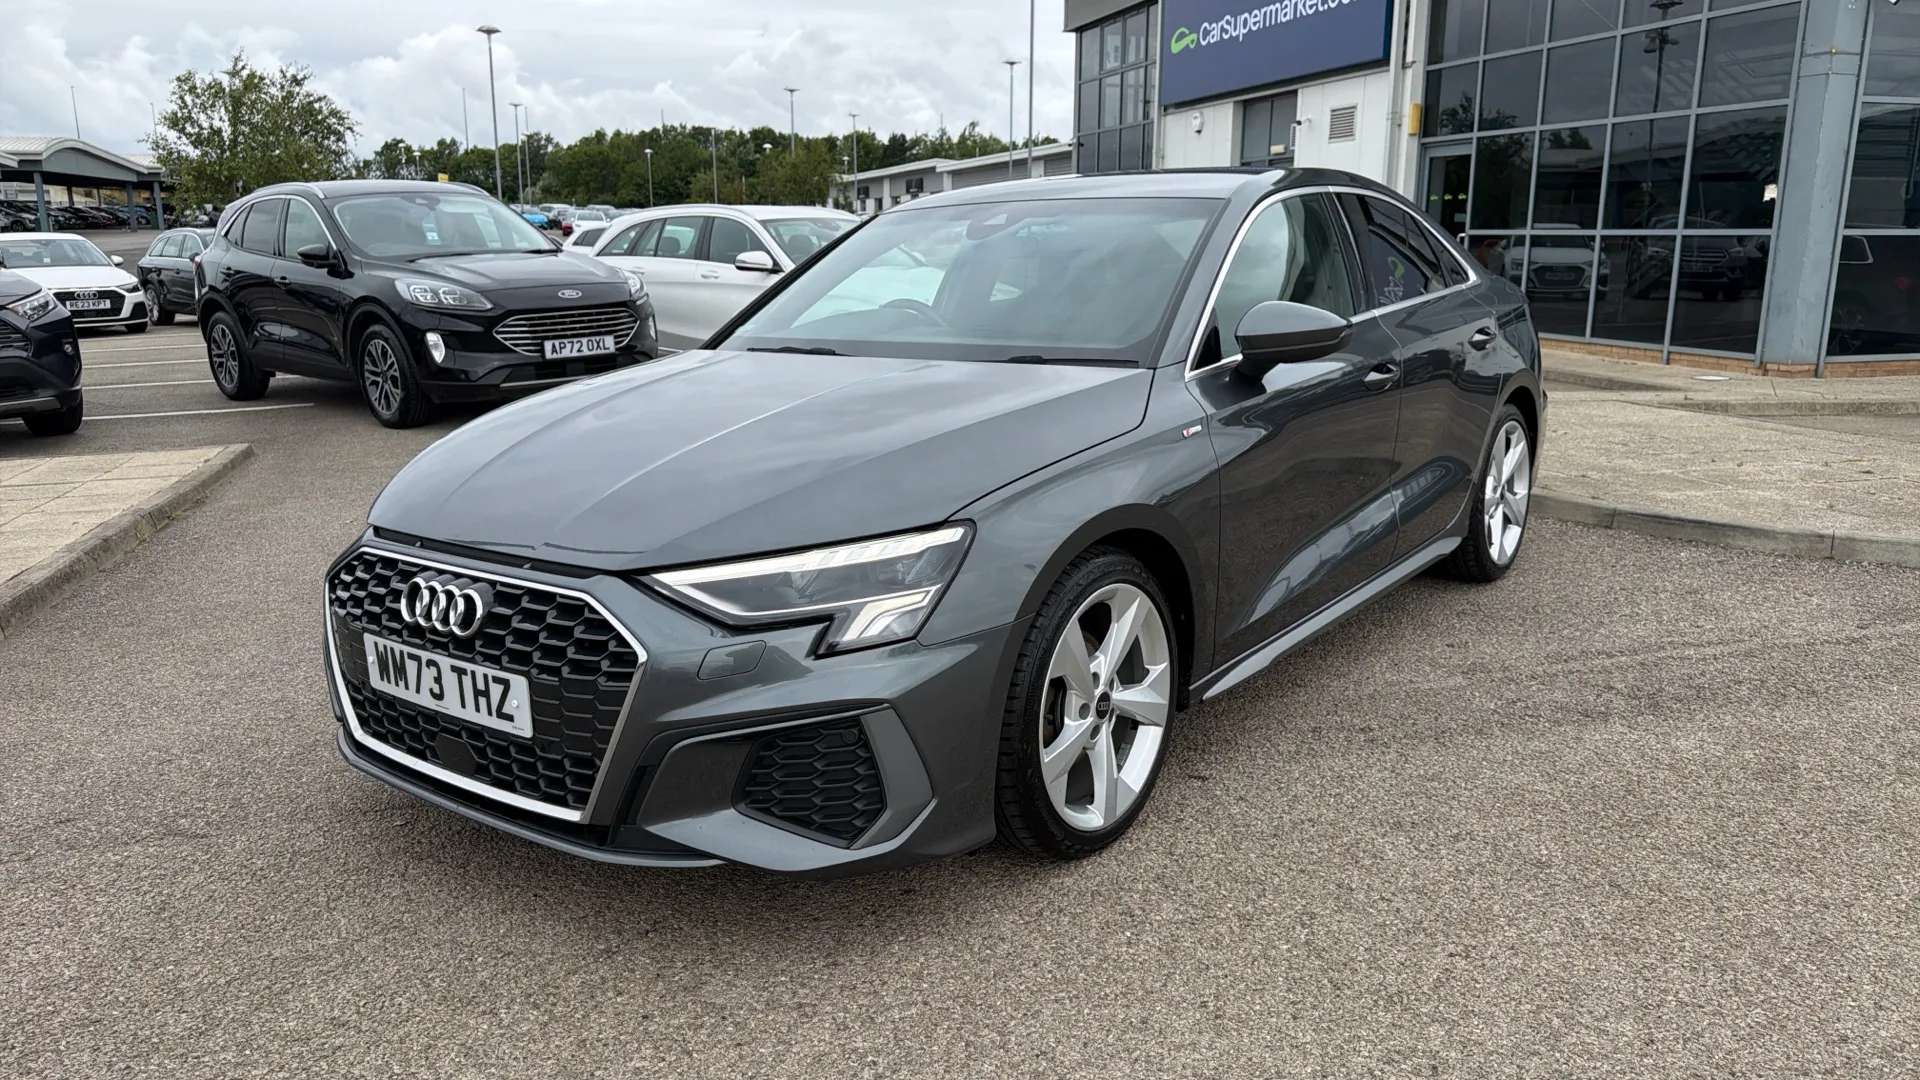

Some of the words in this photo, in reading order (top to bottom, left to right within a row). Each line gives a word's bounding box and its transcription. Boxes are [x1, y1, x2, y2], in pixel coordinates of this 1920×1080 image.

[1199, 0, 1357, 46] CarSupermarket.c
[551, 340, 584, 356] AP72
[587, 337, 610, 352] OXL
[374, 641, 445, 702] WM73
[450, 665, 515, 723] THZ
